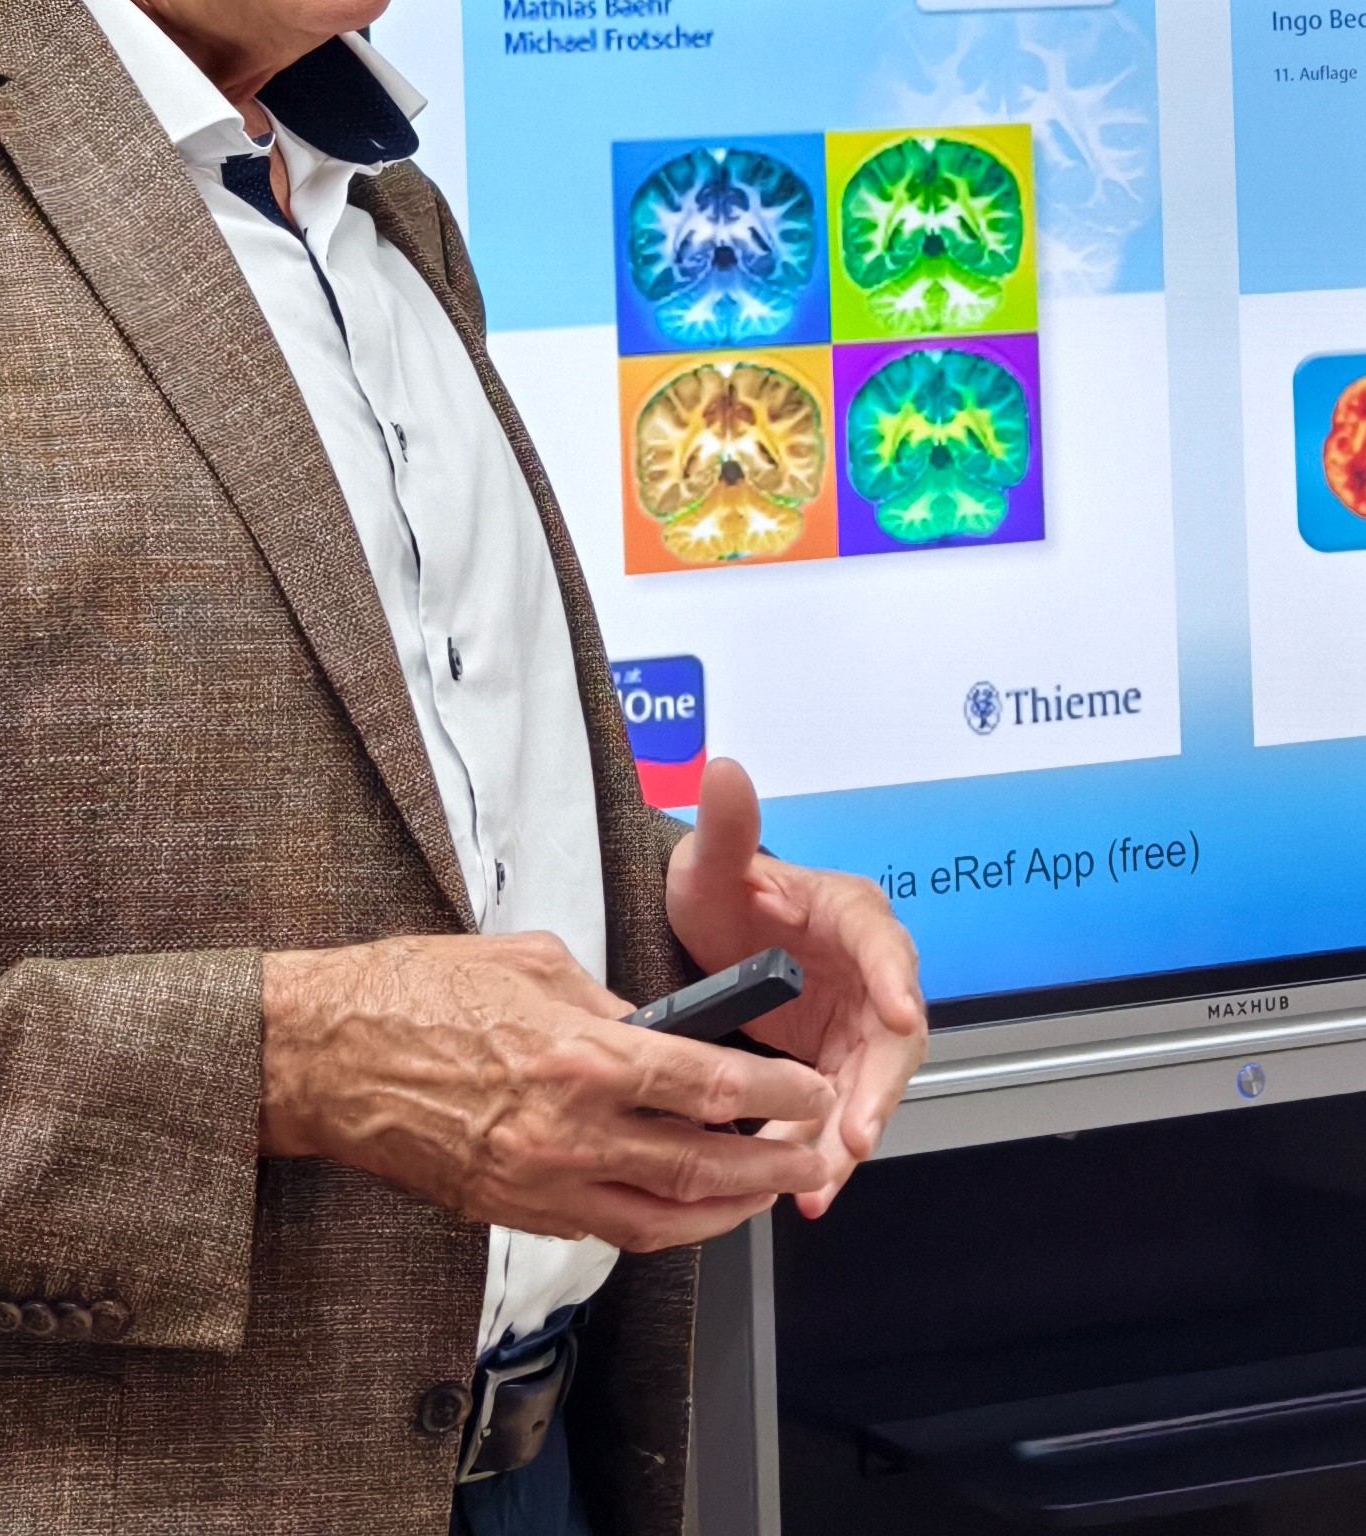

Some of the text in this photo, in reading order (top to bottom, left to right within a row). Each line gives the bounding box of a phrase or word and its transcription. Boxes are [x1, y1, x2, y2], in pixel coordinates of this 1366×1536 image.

[1271, 7, 1323, 34] Ingo
[504, 25, 714, 56] Michael Frotscher
[1273, 64, 1358, 86] 11. Auflage
[1006, 684, 1143, 728] Thieme
[930, 849, 1017, 896] eRef
[1025, 847, 1095, 890] App
[1108, 830, 1200, 884] (free)
[1207, 996, 1290, 1020] MAXHUB
